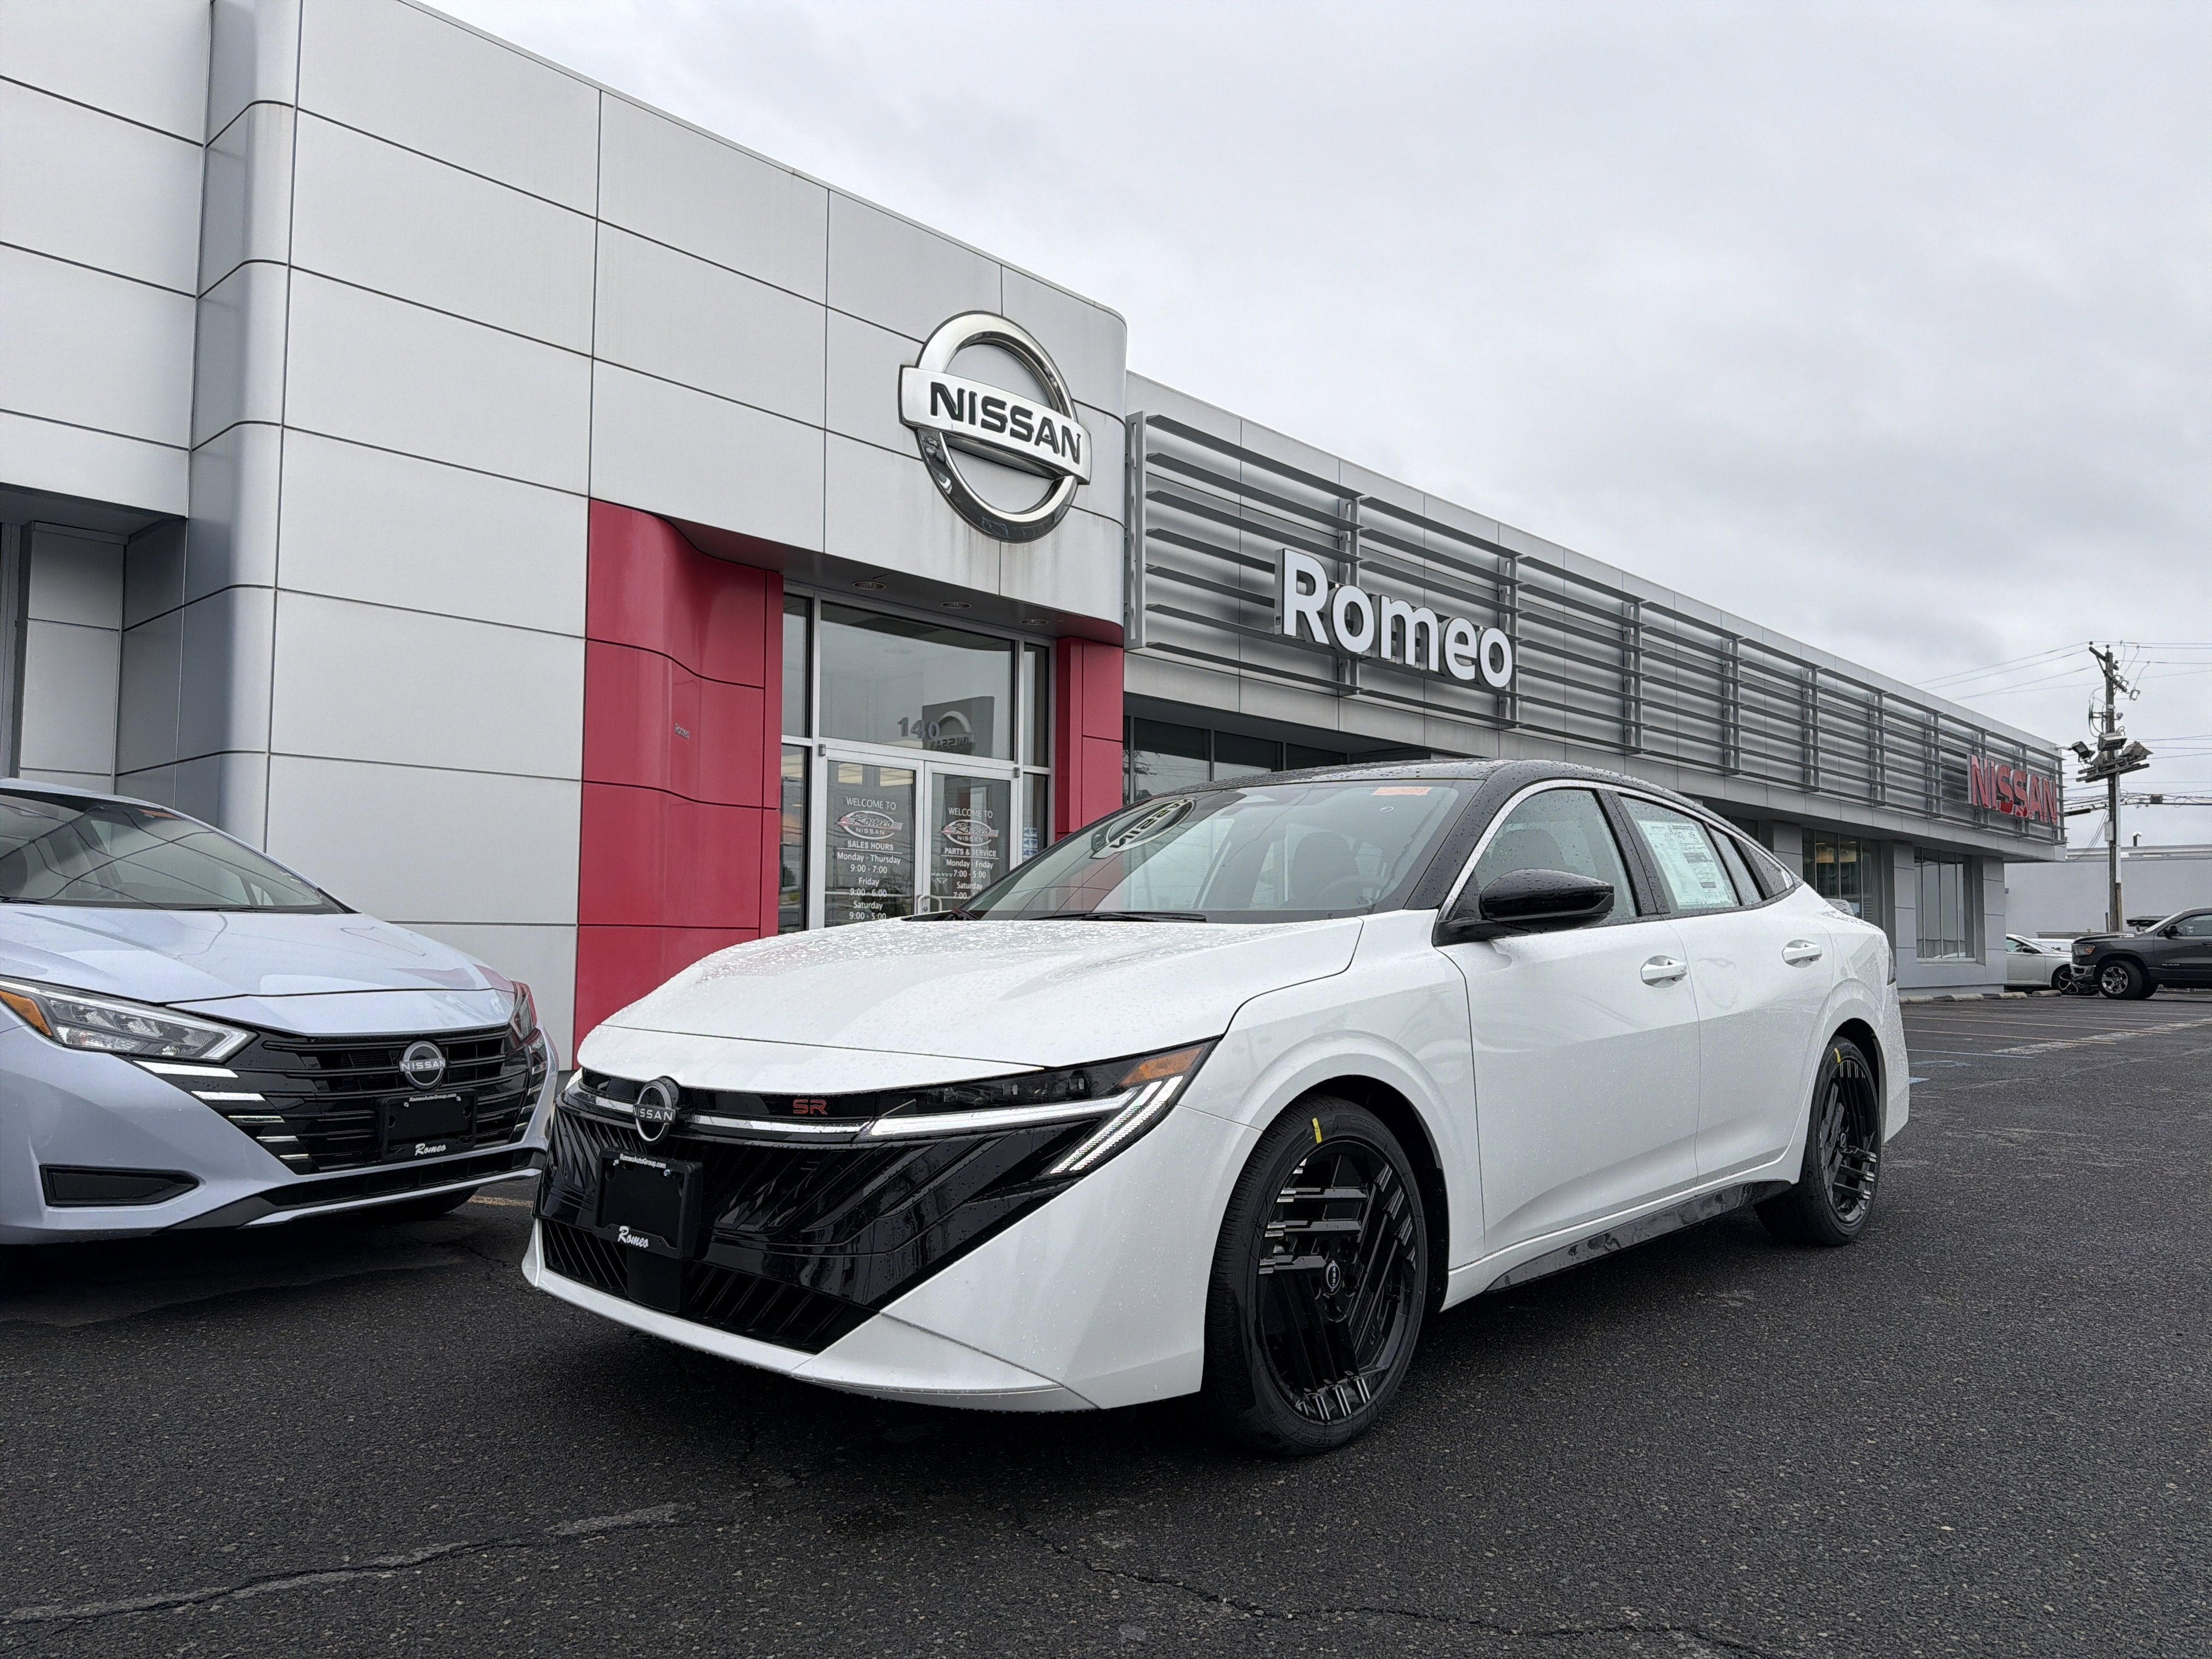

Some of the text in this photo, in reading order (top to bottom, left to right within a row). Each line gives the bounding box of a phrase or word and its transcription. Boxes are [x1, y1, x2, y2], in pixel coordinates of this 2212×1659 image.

[930, 382, 1081, 465] NISSAN
[1280, 548, 1513, 689] Romeo
[898, 716, 940, 740] 140
[1970, 755, 2057, 826] NISSAN
[846, 797, 896, 810] WELCOME TO
[948, 807, 993, 819] WELCOME TO
[852, 812, 893, 828] Romeo
[955, 821, 990, 837] Romeo
[847, 840, 894, 851] SALES HOURS
[944, 847, 964, 855] PARTS
[972, 849, 997, 857] SERVICE
[837, 851, 865, 862] Monday
[870, 854, 901, 865] Thursday
[946, 859, 970, 868] Monday
[975, 861, 994, 870] Friday
[850, 864, 866, 873] 9:00
[872, 865, 888, 874] 7:00
[859, 877, 880, 887] Friday
[956, 881, 983, 891] Saturday
[850, 888, 866, 896] 9:00
[872, 889, 887, 897] 6:00
[853, 900, 883, 911] Saturday
[849, 911, 865, 920] 9:00
[401, 1060, 445, 1070] NISSAN
[793, 1098, 828, 1115] SR
[633, 1106, 673, 1121] NISSAN
[414, 1143, 446, 1156] Romeo
[619, 1153, 667, 1169] RomeoAutoGroup.com
[617, 1226, 649, 1248] Romeo
